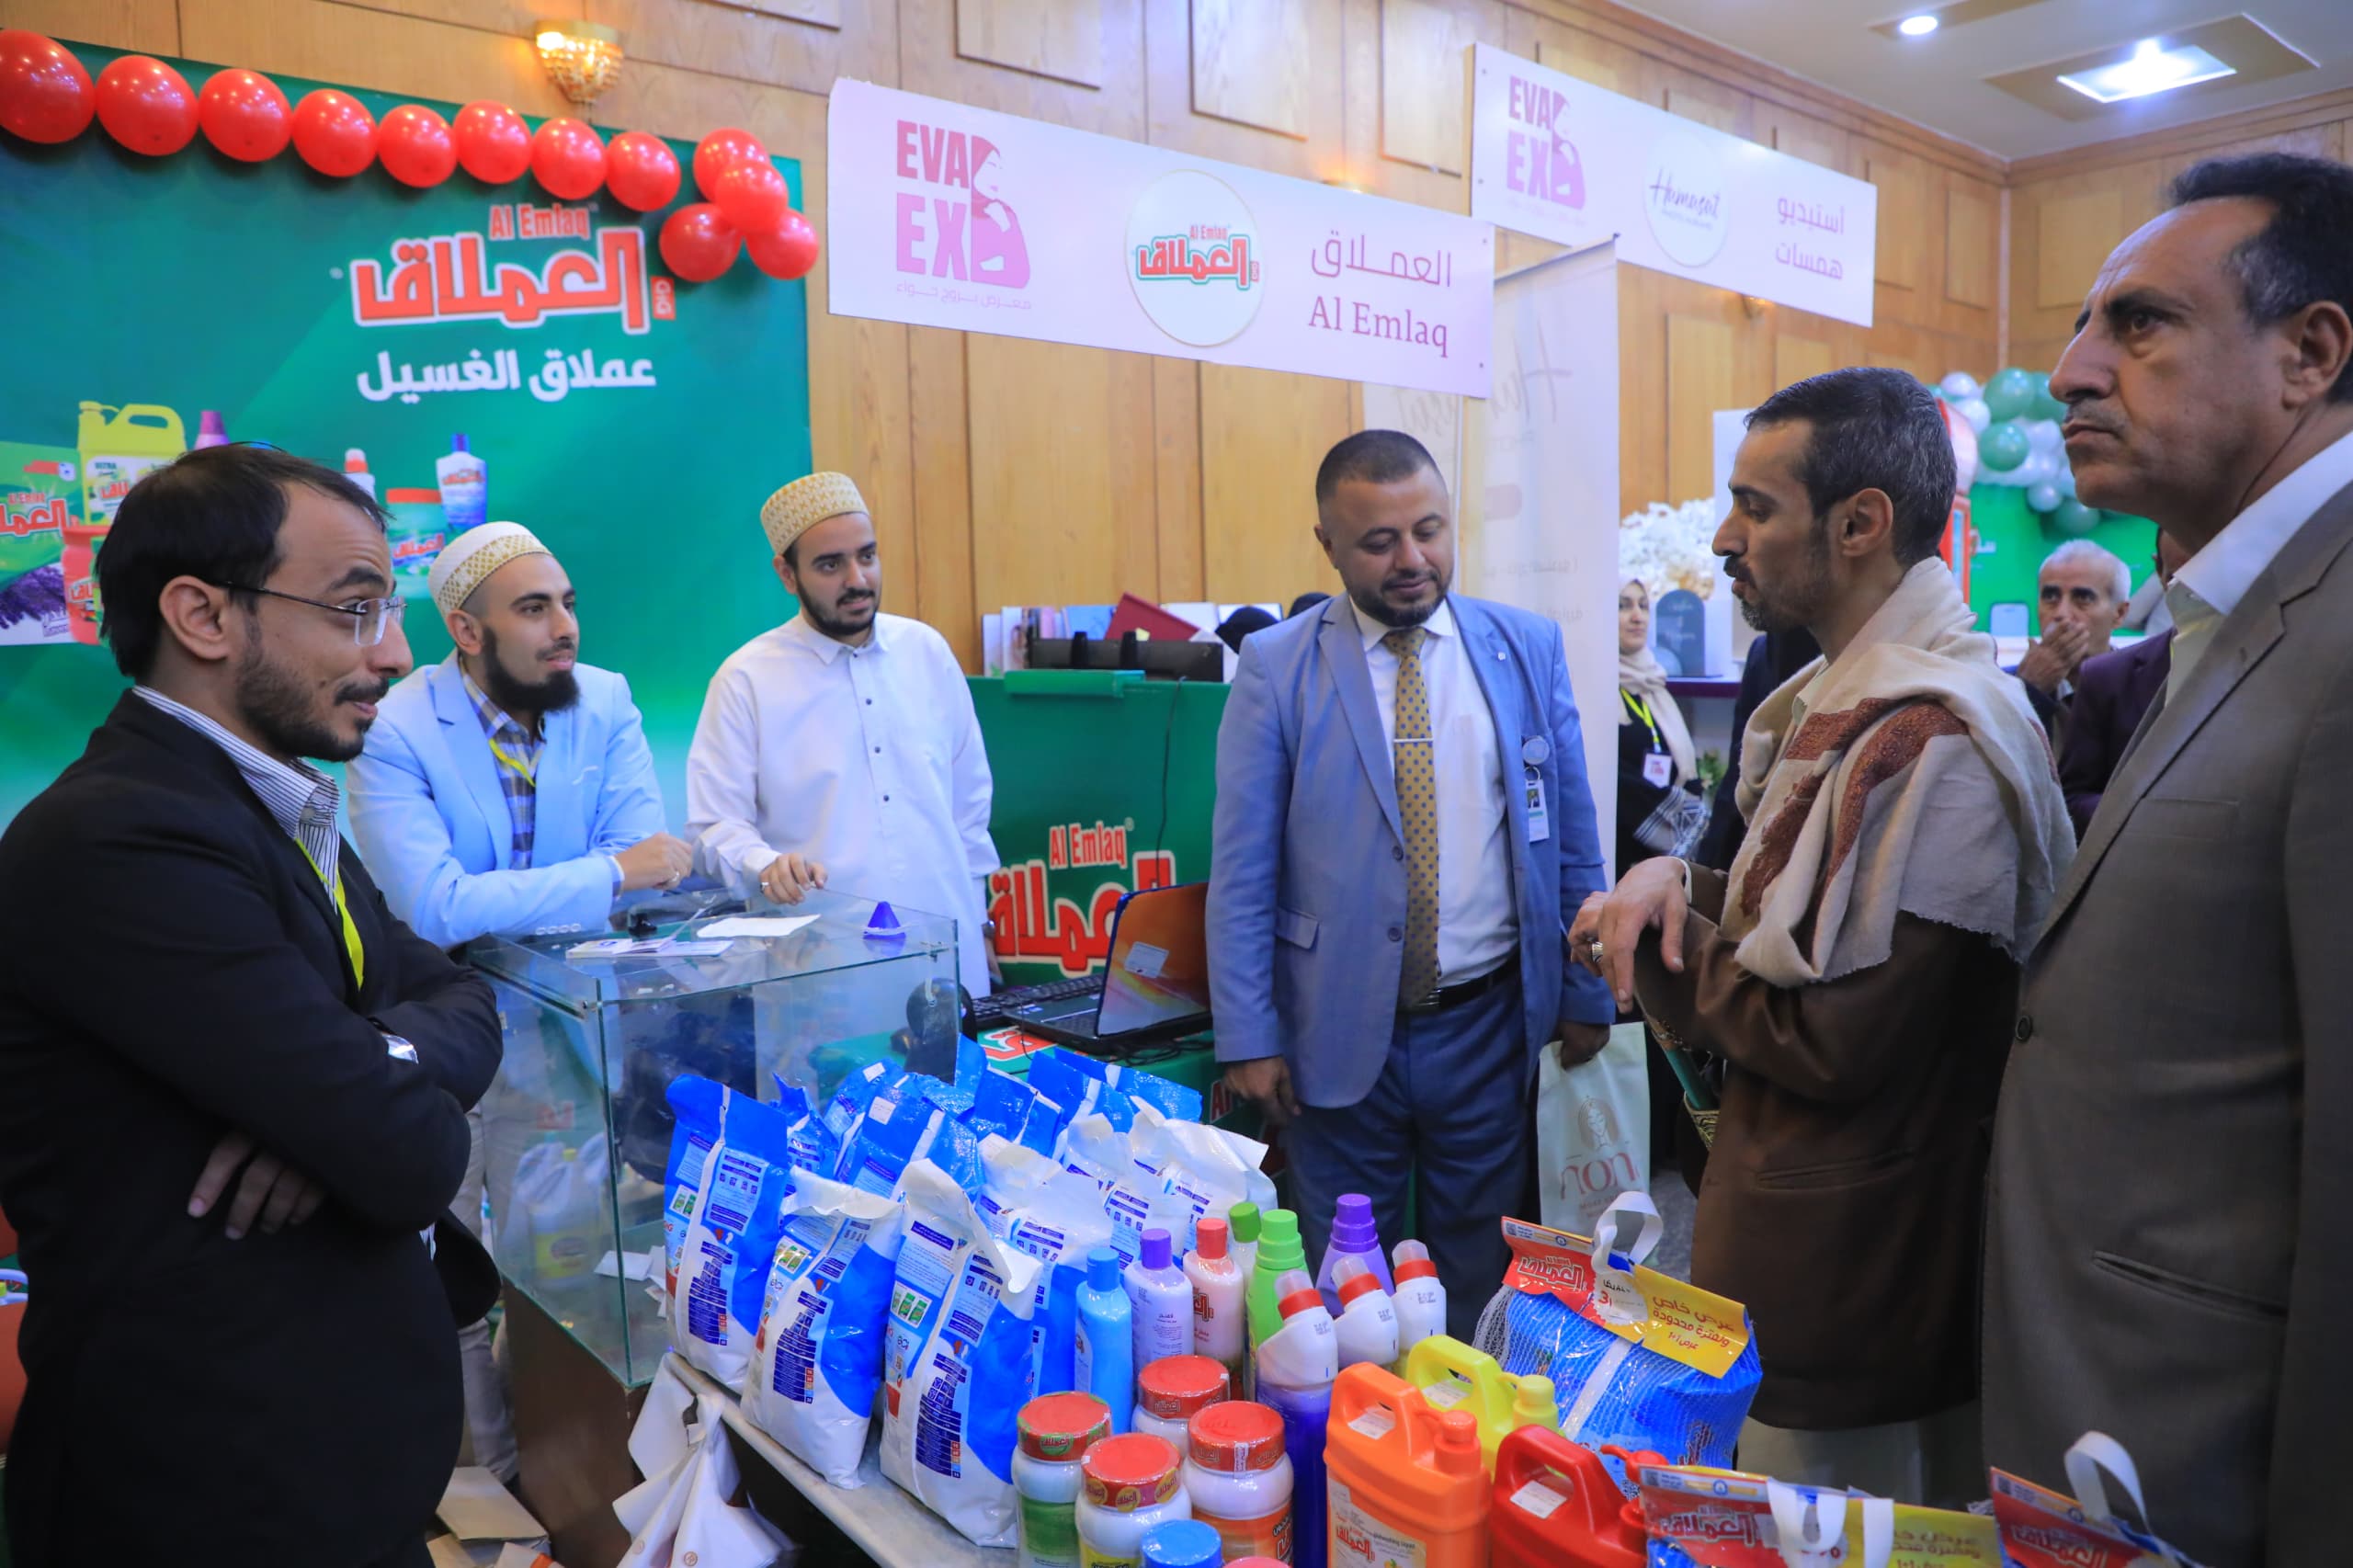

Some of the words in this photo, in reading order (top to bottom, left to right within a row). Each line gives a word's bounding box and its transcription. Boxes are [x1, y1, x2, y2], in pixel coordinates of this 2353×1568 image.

[1508, 74, 1551, 131] EVA
[897, 119, 970, 189] EVA
[489, 204, 514, 241] Al
[517, 202, 591, 241] Emlaq
[350, 227, 651, 335] العملاق
[1137, 235, 1250, 290] العملاق
[1312, 230, 1450, 287] العملاق
[1776, 242, 1843, 280] همسات
[1309, 295, 1342, 331] Al
[1351, 301, 1449, 359] Emlaq
[357, 348, 522, 403] الغسيل
[529, 348, 656, 402] عملاق
[1050, 825, 1068, 869] Al
[1069, 821, 1128, 869] Emlaq
